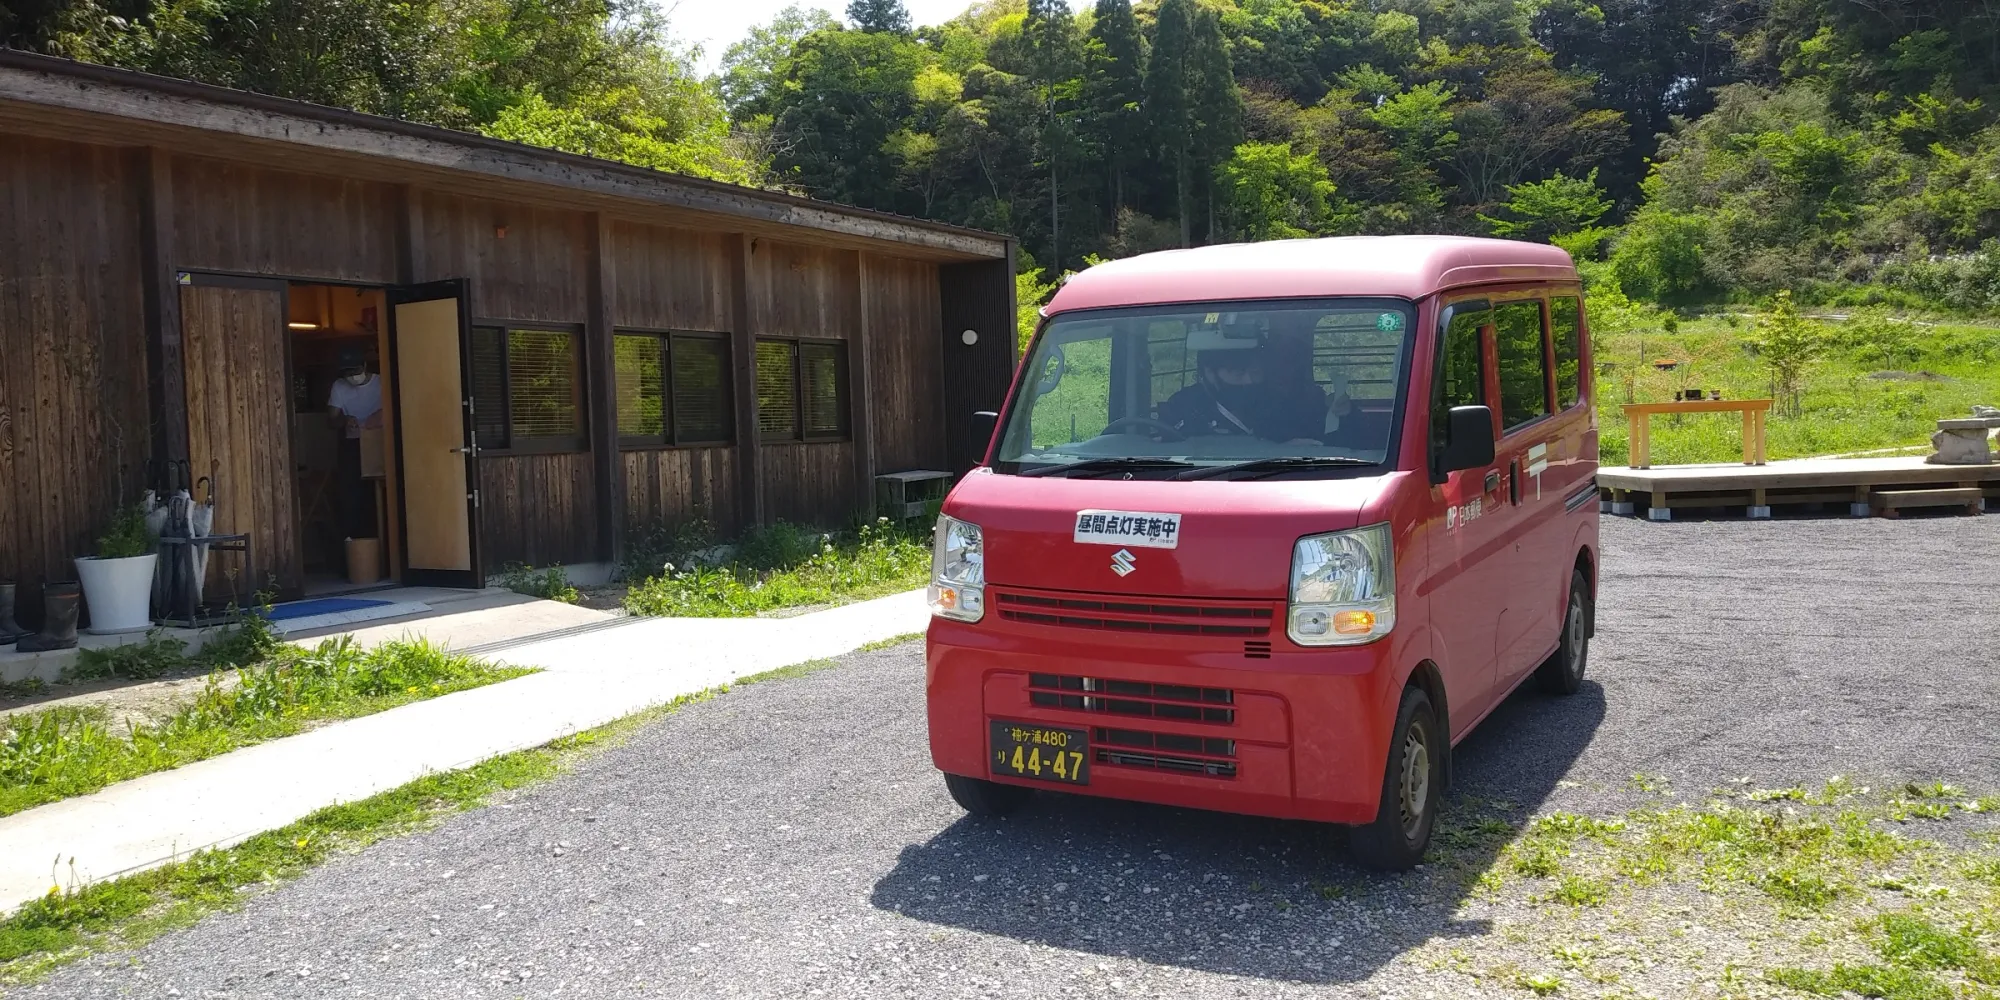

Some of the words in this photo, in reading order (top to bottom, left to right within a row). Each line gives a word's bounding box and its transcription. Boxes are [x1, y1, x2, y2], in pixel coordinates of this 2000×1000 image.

[1078, 514, 1177, 539] 昼間点灯実施中
[1011, 745, 1084, 781] 44-47
